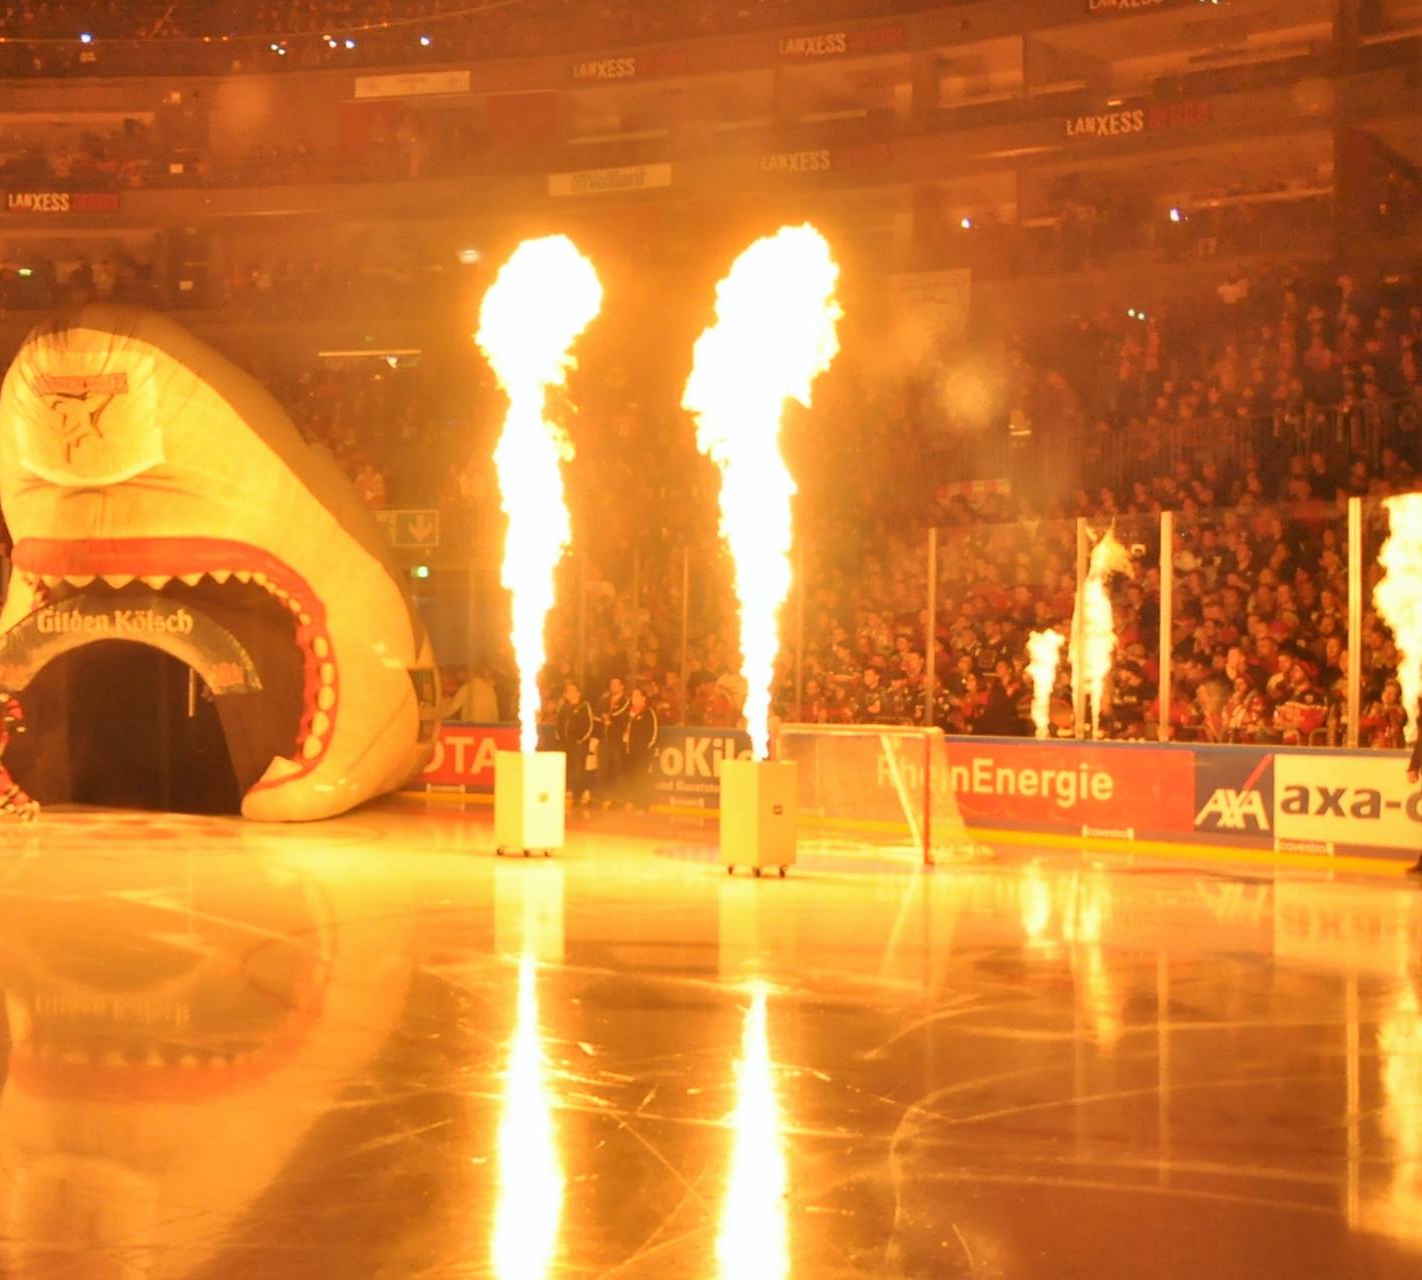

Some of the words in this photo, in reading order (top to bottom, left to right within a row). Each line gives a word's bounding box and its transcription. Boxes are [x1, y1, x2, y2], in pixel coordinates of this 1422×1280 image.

[780, 32, 847, 57] LANXESS
[573, 57, 635, 79] LANXESS
[1066, 108, 1145, 138] LANXESS
[760, 150, 830, 172] LANXESS
[8, 192, 70, 212] LANXESS
[37, 609, 111, 634] Gilden
[114, 609, 194, 634] Kölsch
[1194, 788, 1270, 830] AXA
